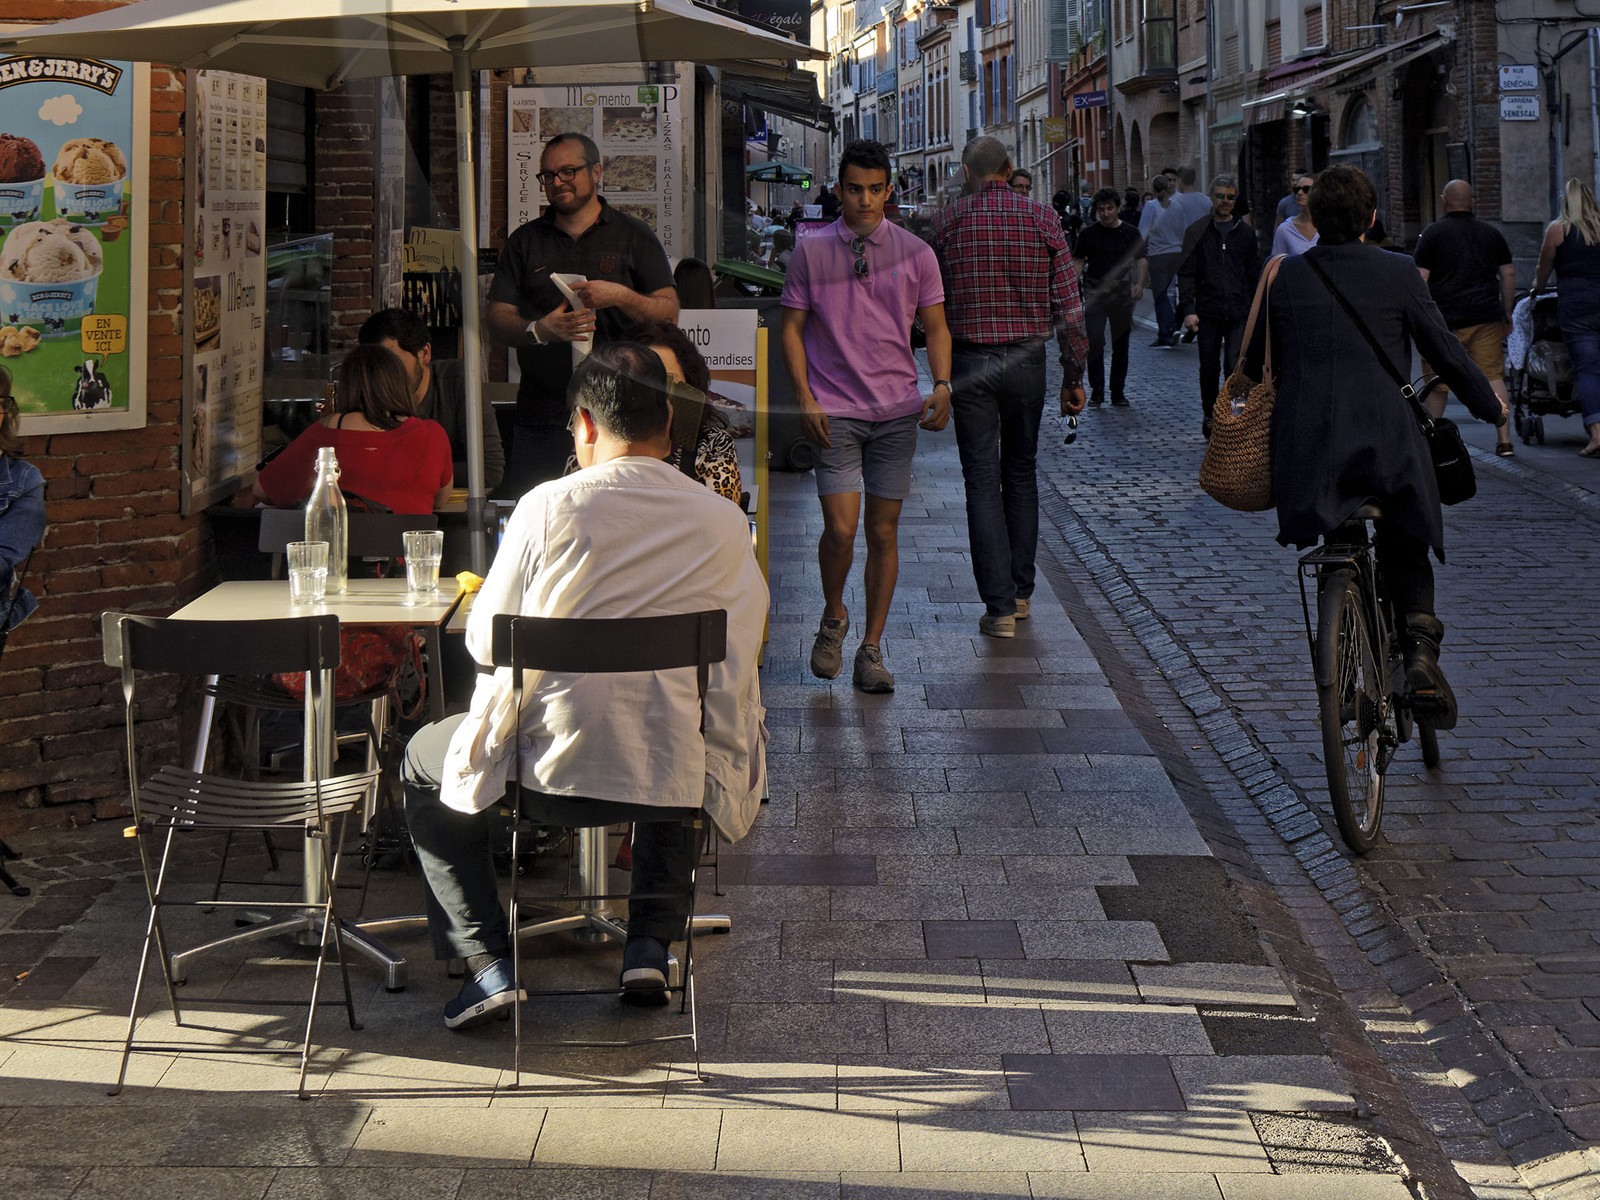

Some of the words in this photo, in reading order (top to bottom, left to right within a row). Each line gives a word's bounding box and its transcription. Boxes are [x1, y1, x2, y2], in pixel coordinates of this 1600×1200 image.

[0, 59, 116, 88] EN&JERRY'S
[96, 318, 111, 329] EN
[86, 330, 122, 341] VENTE
[95, 341, 112, 351] ICI
